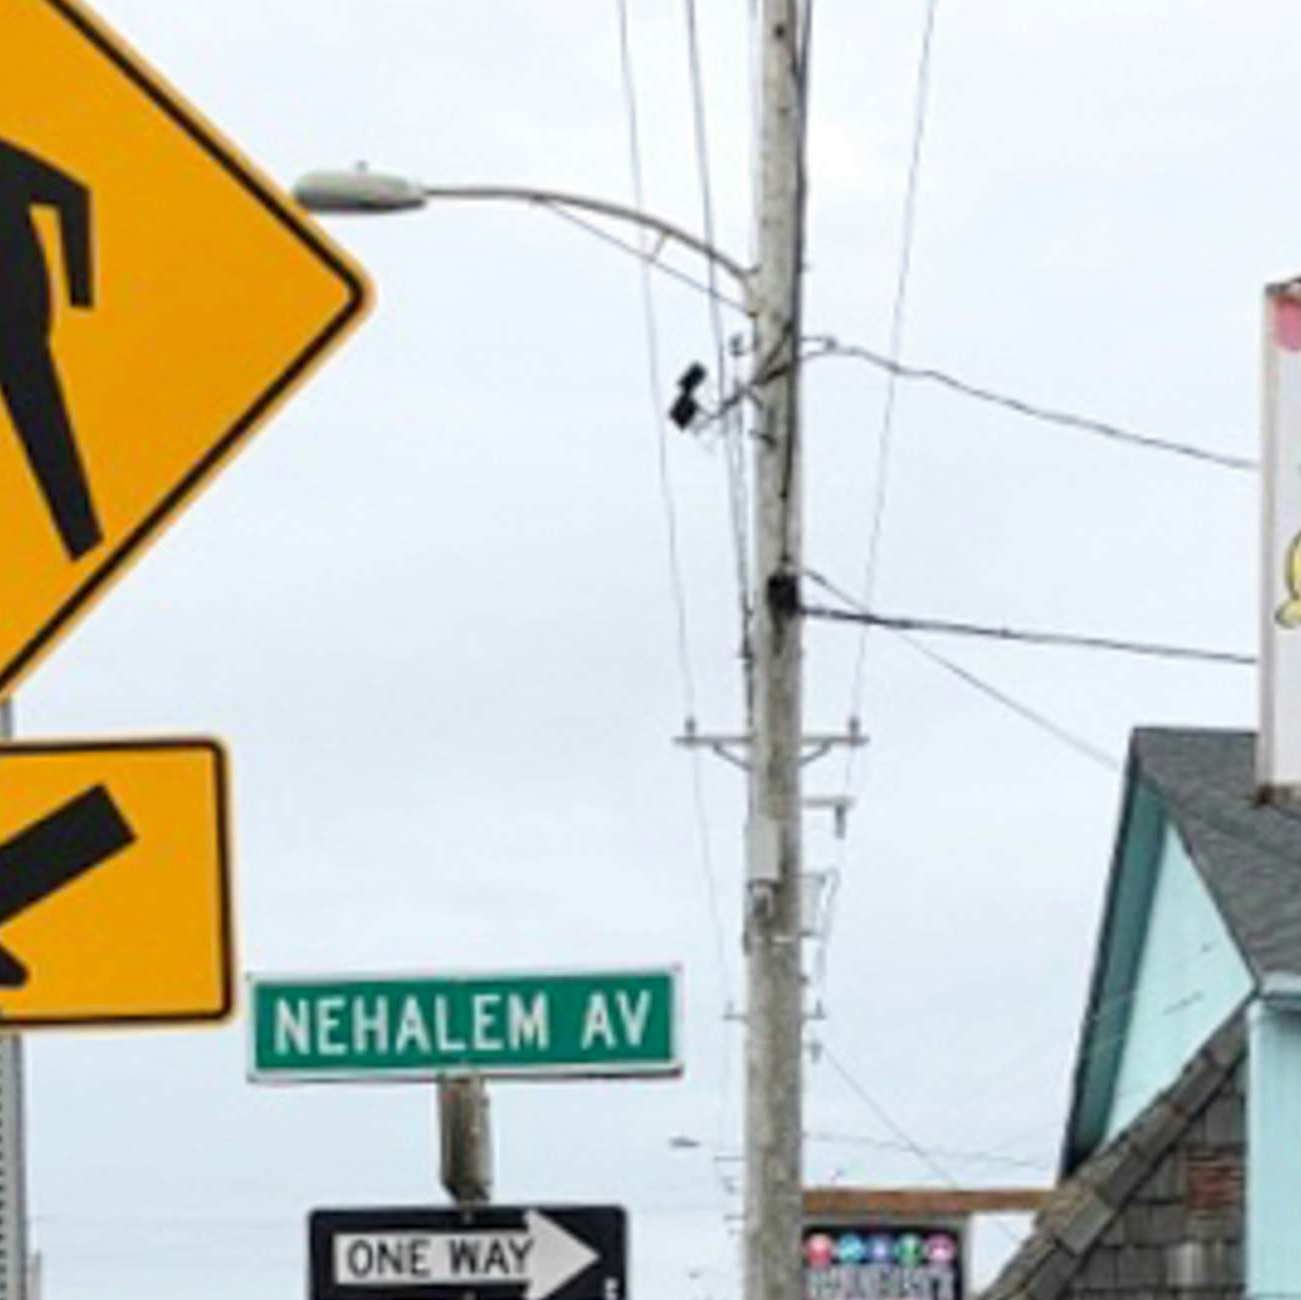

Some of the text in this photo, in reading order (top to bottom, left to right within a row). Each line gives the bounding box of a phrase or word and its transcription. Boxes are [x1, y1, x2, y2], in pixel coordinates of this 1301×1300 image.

[274, 990, 651, 1056] NEHALEM AV
[346, 1237, 535, 1280] ONE WAY
